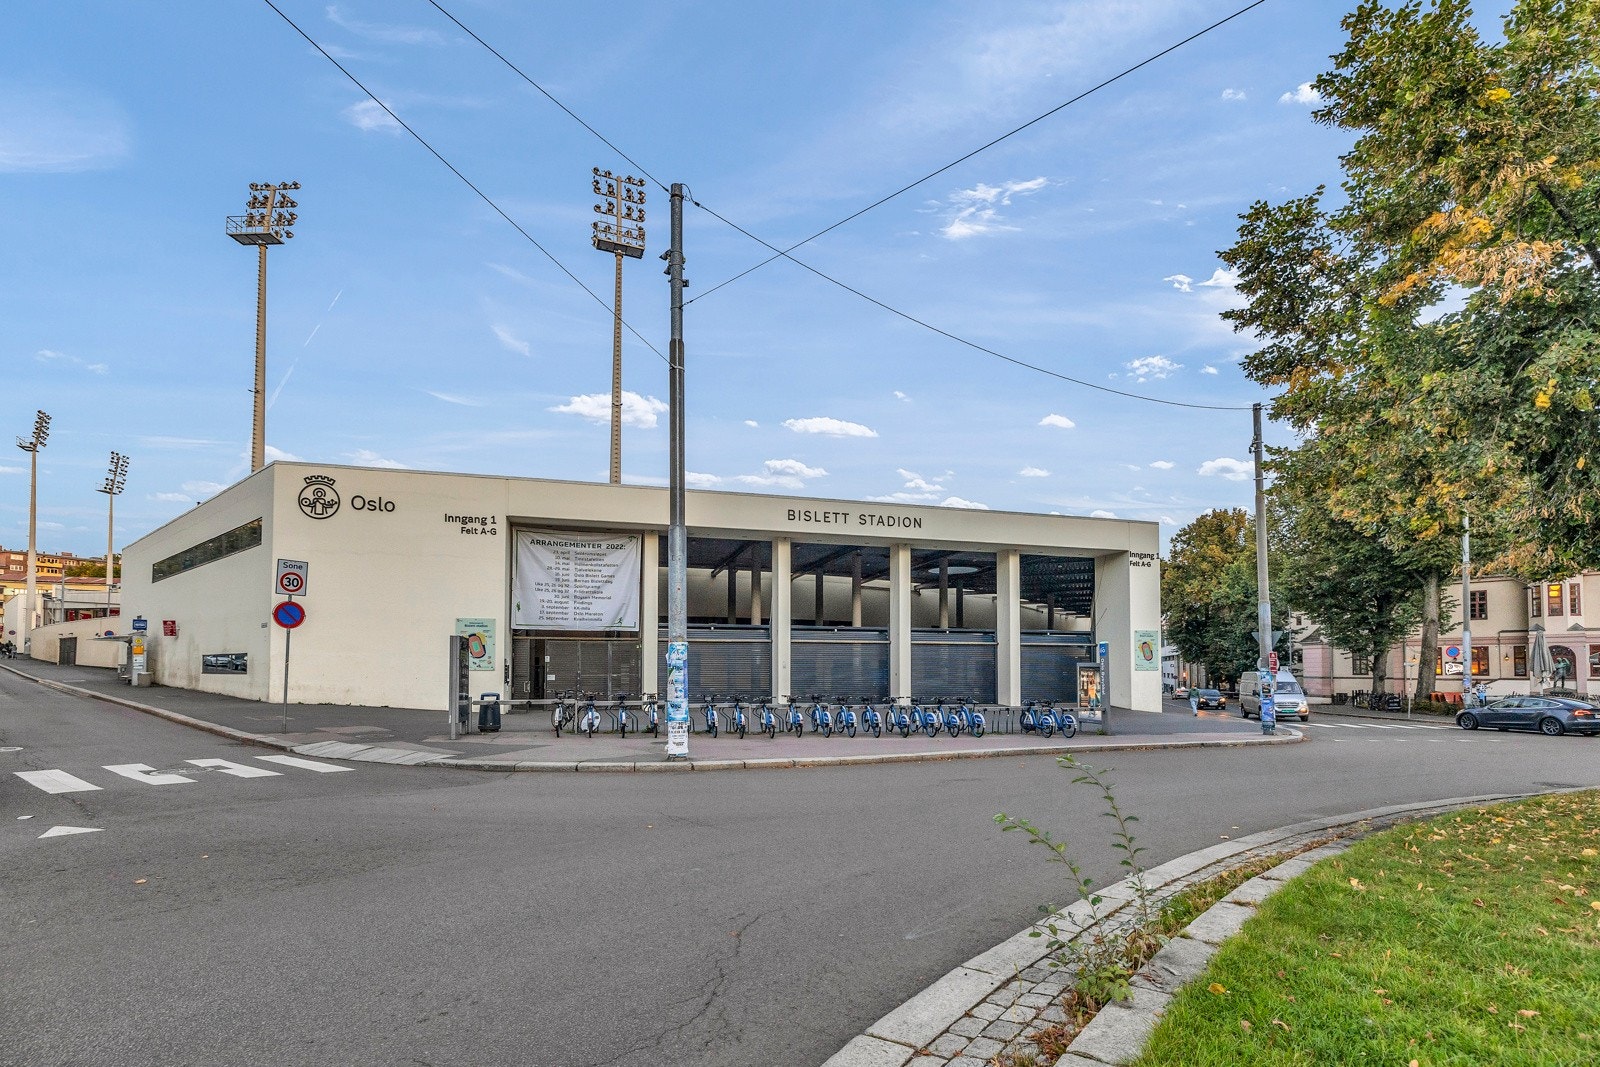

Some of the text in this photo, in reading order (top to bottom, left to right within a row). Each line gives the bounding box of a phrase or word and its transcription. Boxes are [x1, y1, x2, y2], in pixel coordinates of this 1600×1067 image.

[351, 495, 396, 512] Oslo
[444, 513, 497, 526] Inngang 1
[787, 509, 922, 529] BISLETT STADION
[460, 526, 497, 536] Felt A-G
[529, 539, 602, 550] ARRANGEMENTER
[1129, 551, 1160, 561] Inngang 1
[283, 562, 303, 570] Sone
[284, 577, 300, 588] 30
